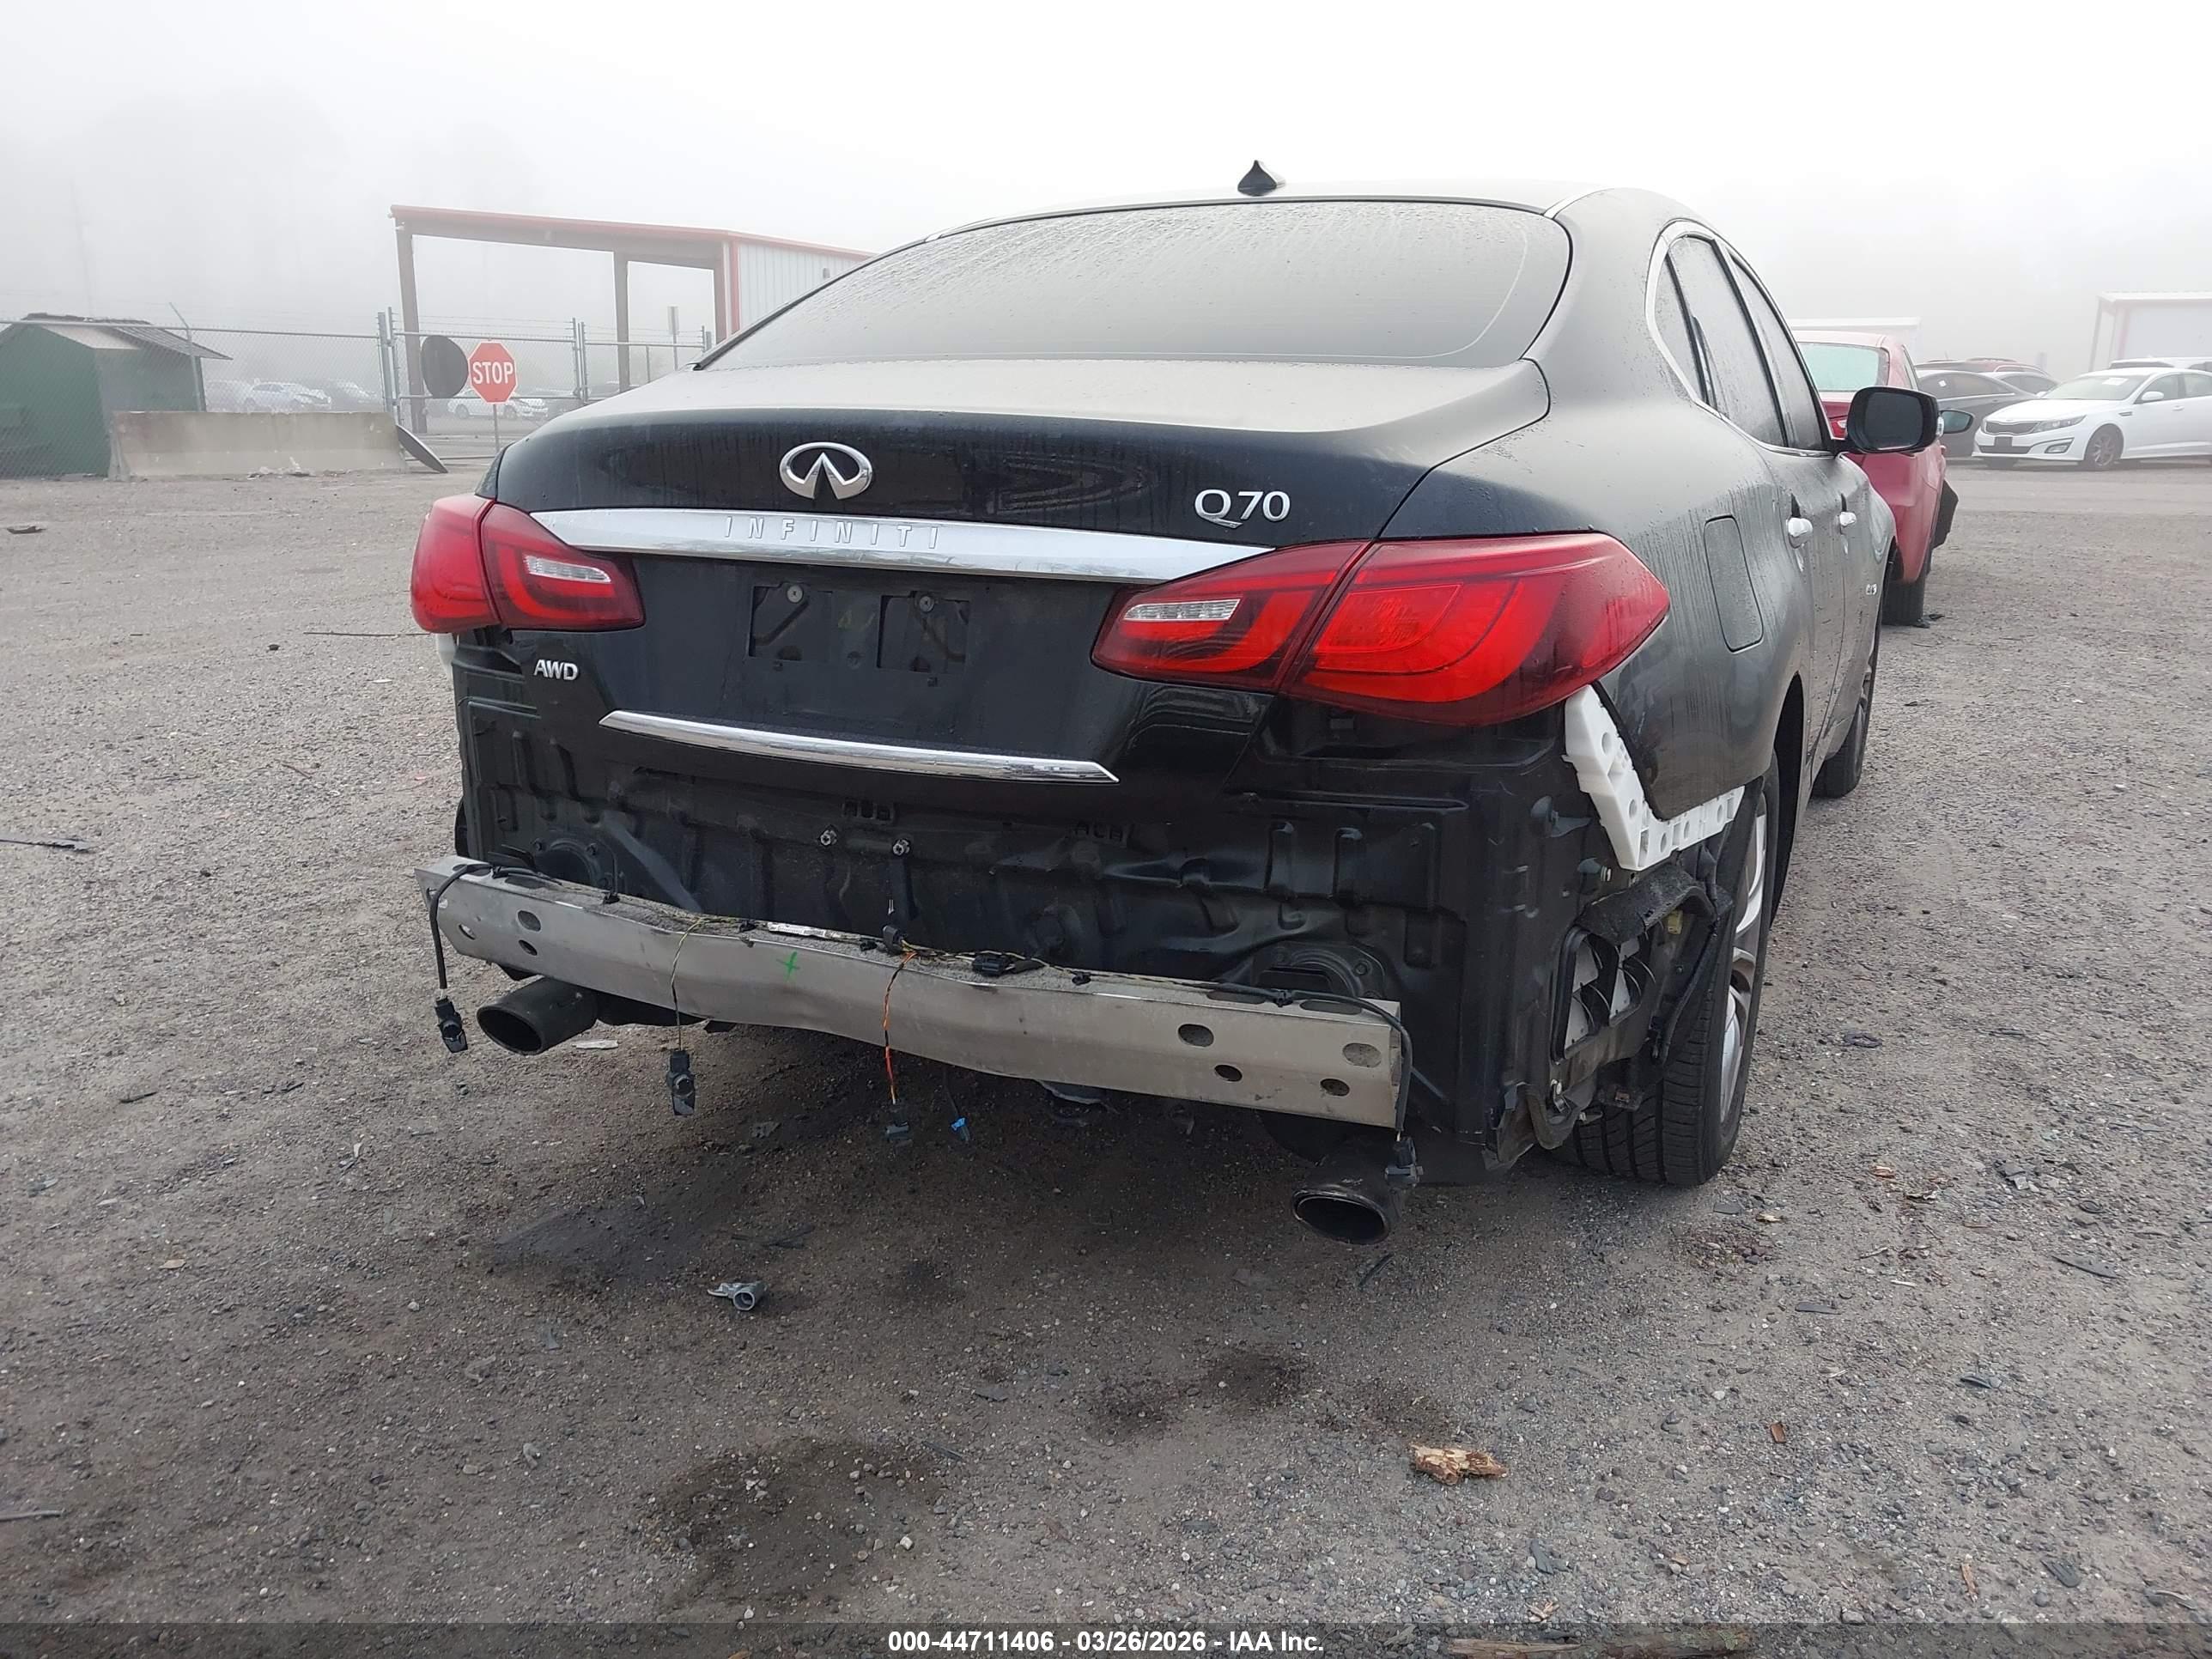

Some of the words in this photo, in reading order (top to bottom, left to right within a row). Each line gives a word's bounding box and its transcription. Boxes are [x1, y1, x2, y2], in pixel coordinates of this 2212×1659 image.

[472, 362, 514, 385] STOP
[1194, 489, 1291, 529] Q70
[724, 516, 939, 550] INFINITI
[533, 659, 579, 681] AWD
